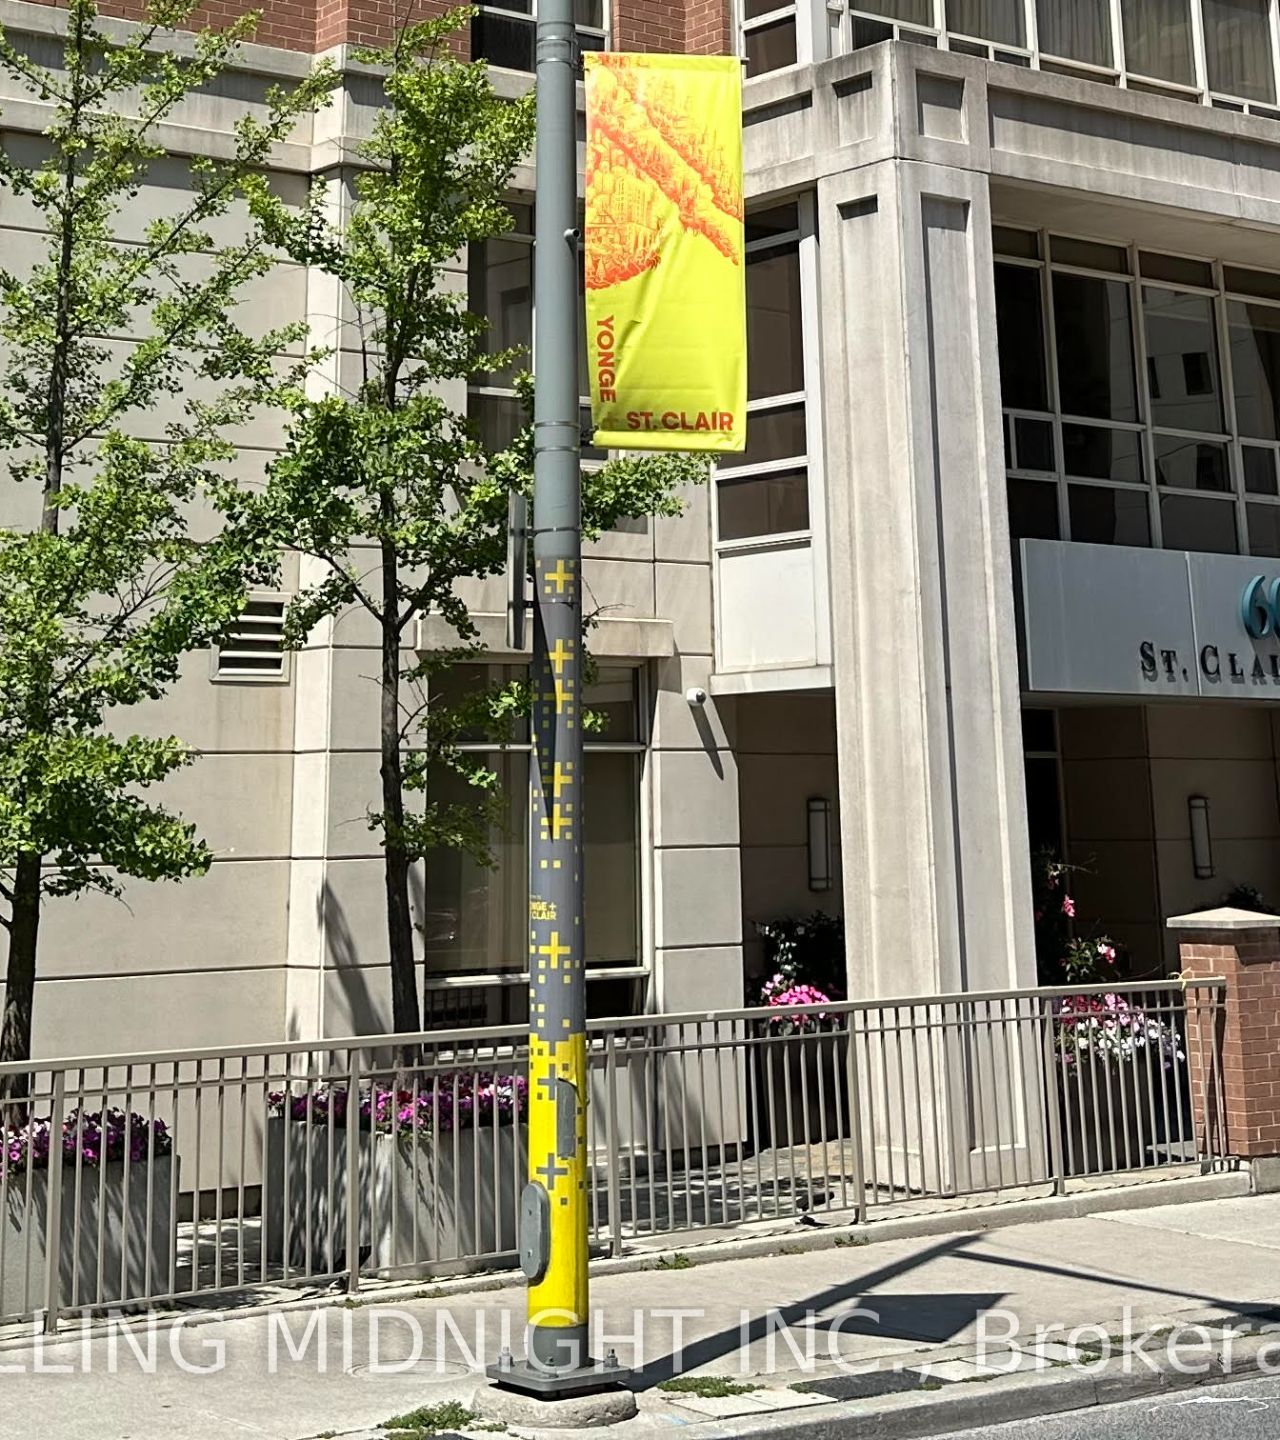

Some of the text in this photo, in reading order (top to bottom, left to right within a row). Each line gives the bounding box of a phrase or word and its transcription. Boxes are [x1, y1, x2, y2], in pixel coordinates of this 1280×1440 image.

[597, 315, 616, 403] YONGE
[626, 411, 734, 431] ST. CLAIR
